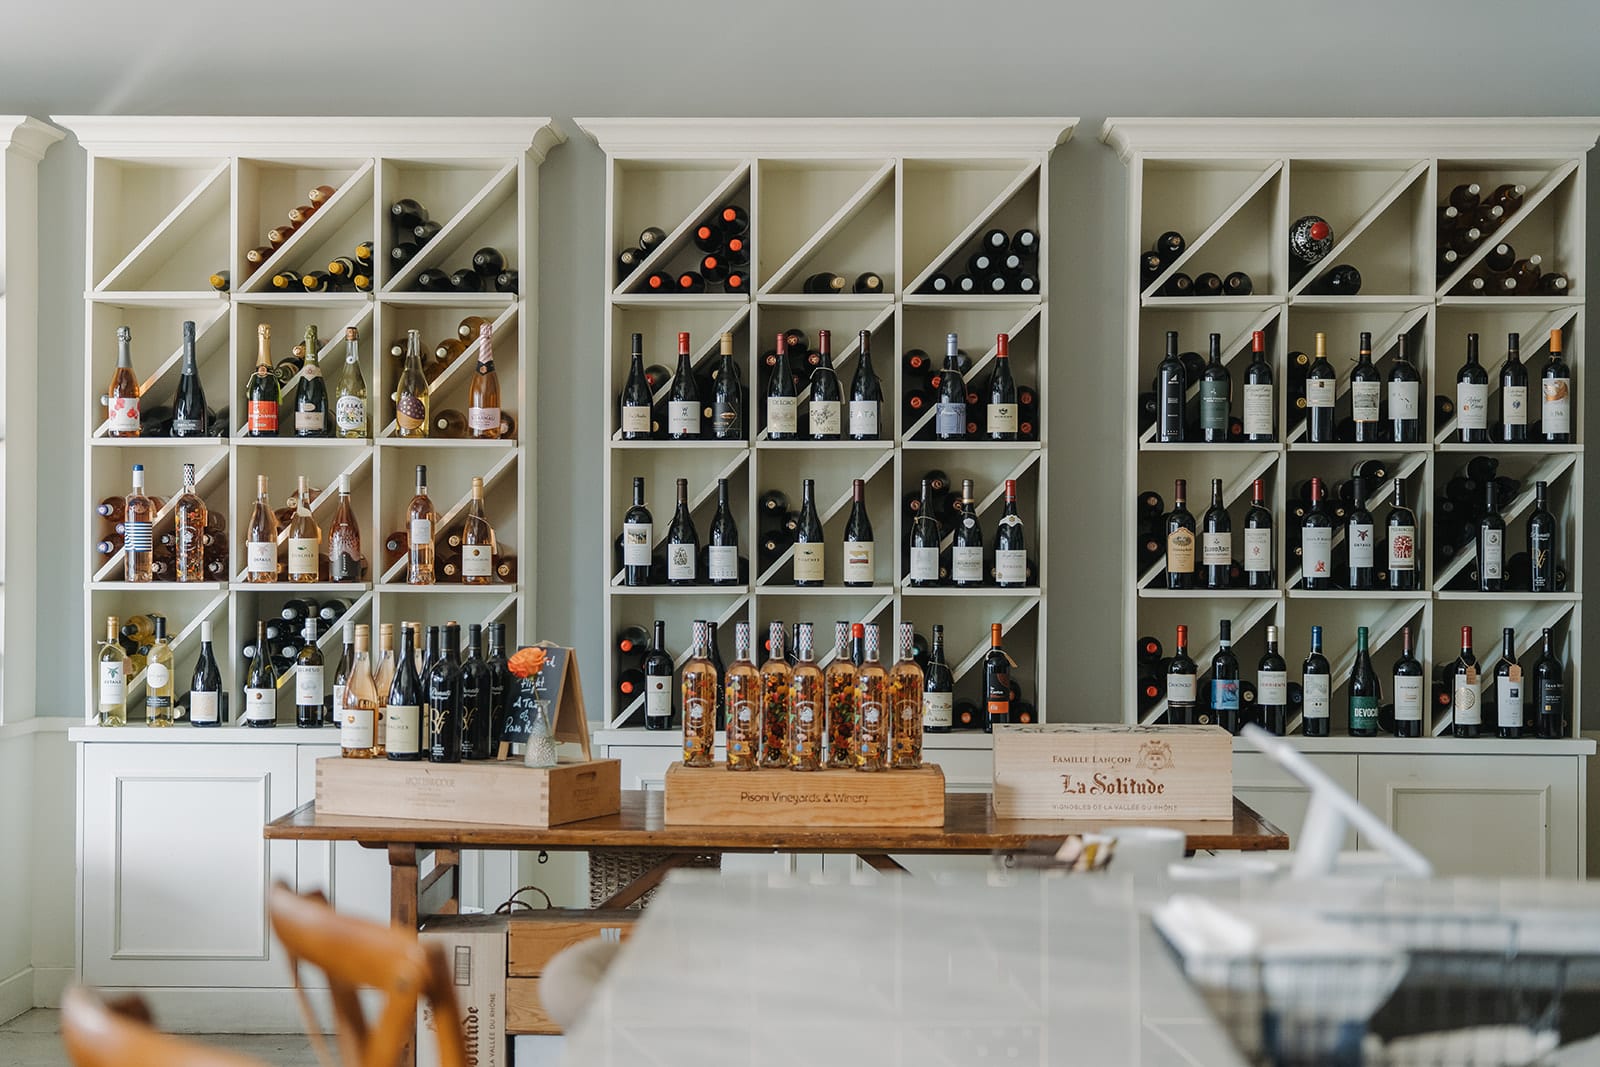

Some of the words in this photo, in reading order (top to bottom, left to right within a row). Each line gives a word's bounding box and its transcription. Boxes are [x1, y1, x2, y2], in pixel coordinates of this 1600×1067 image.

[523, 698, 538, 708] Tas
[1052, 755, 1089, 763] FAMILLE
[1092, 755, 1132, 765] LANÇON
[1060, 773, 1086, 794] La
[1089, 772, 1165, 795] Solitude
[740, 791, 770, 802] Pisoni
[771, 791, 821, 805] Vineyards
[823, 793, 831, 803] &
[833, 793, 869, 804] Winery
[1103, 803, 1113, 811] LA
[488, 1019, 496, 1030] DU
[461, 1006, 479, 1067] olitude
